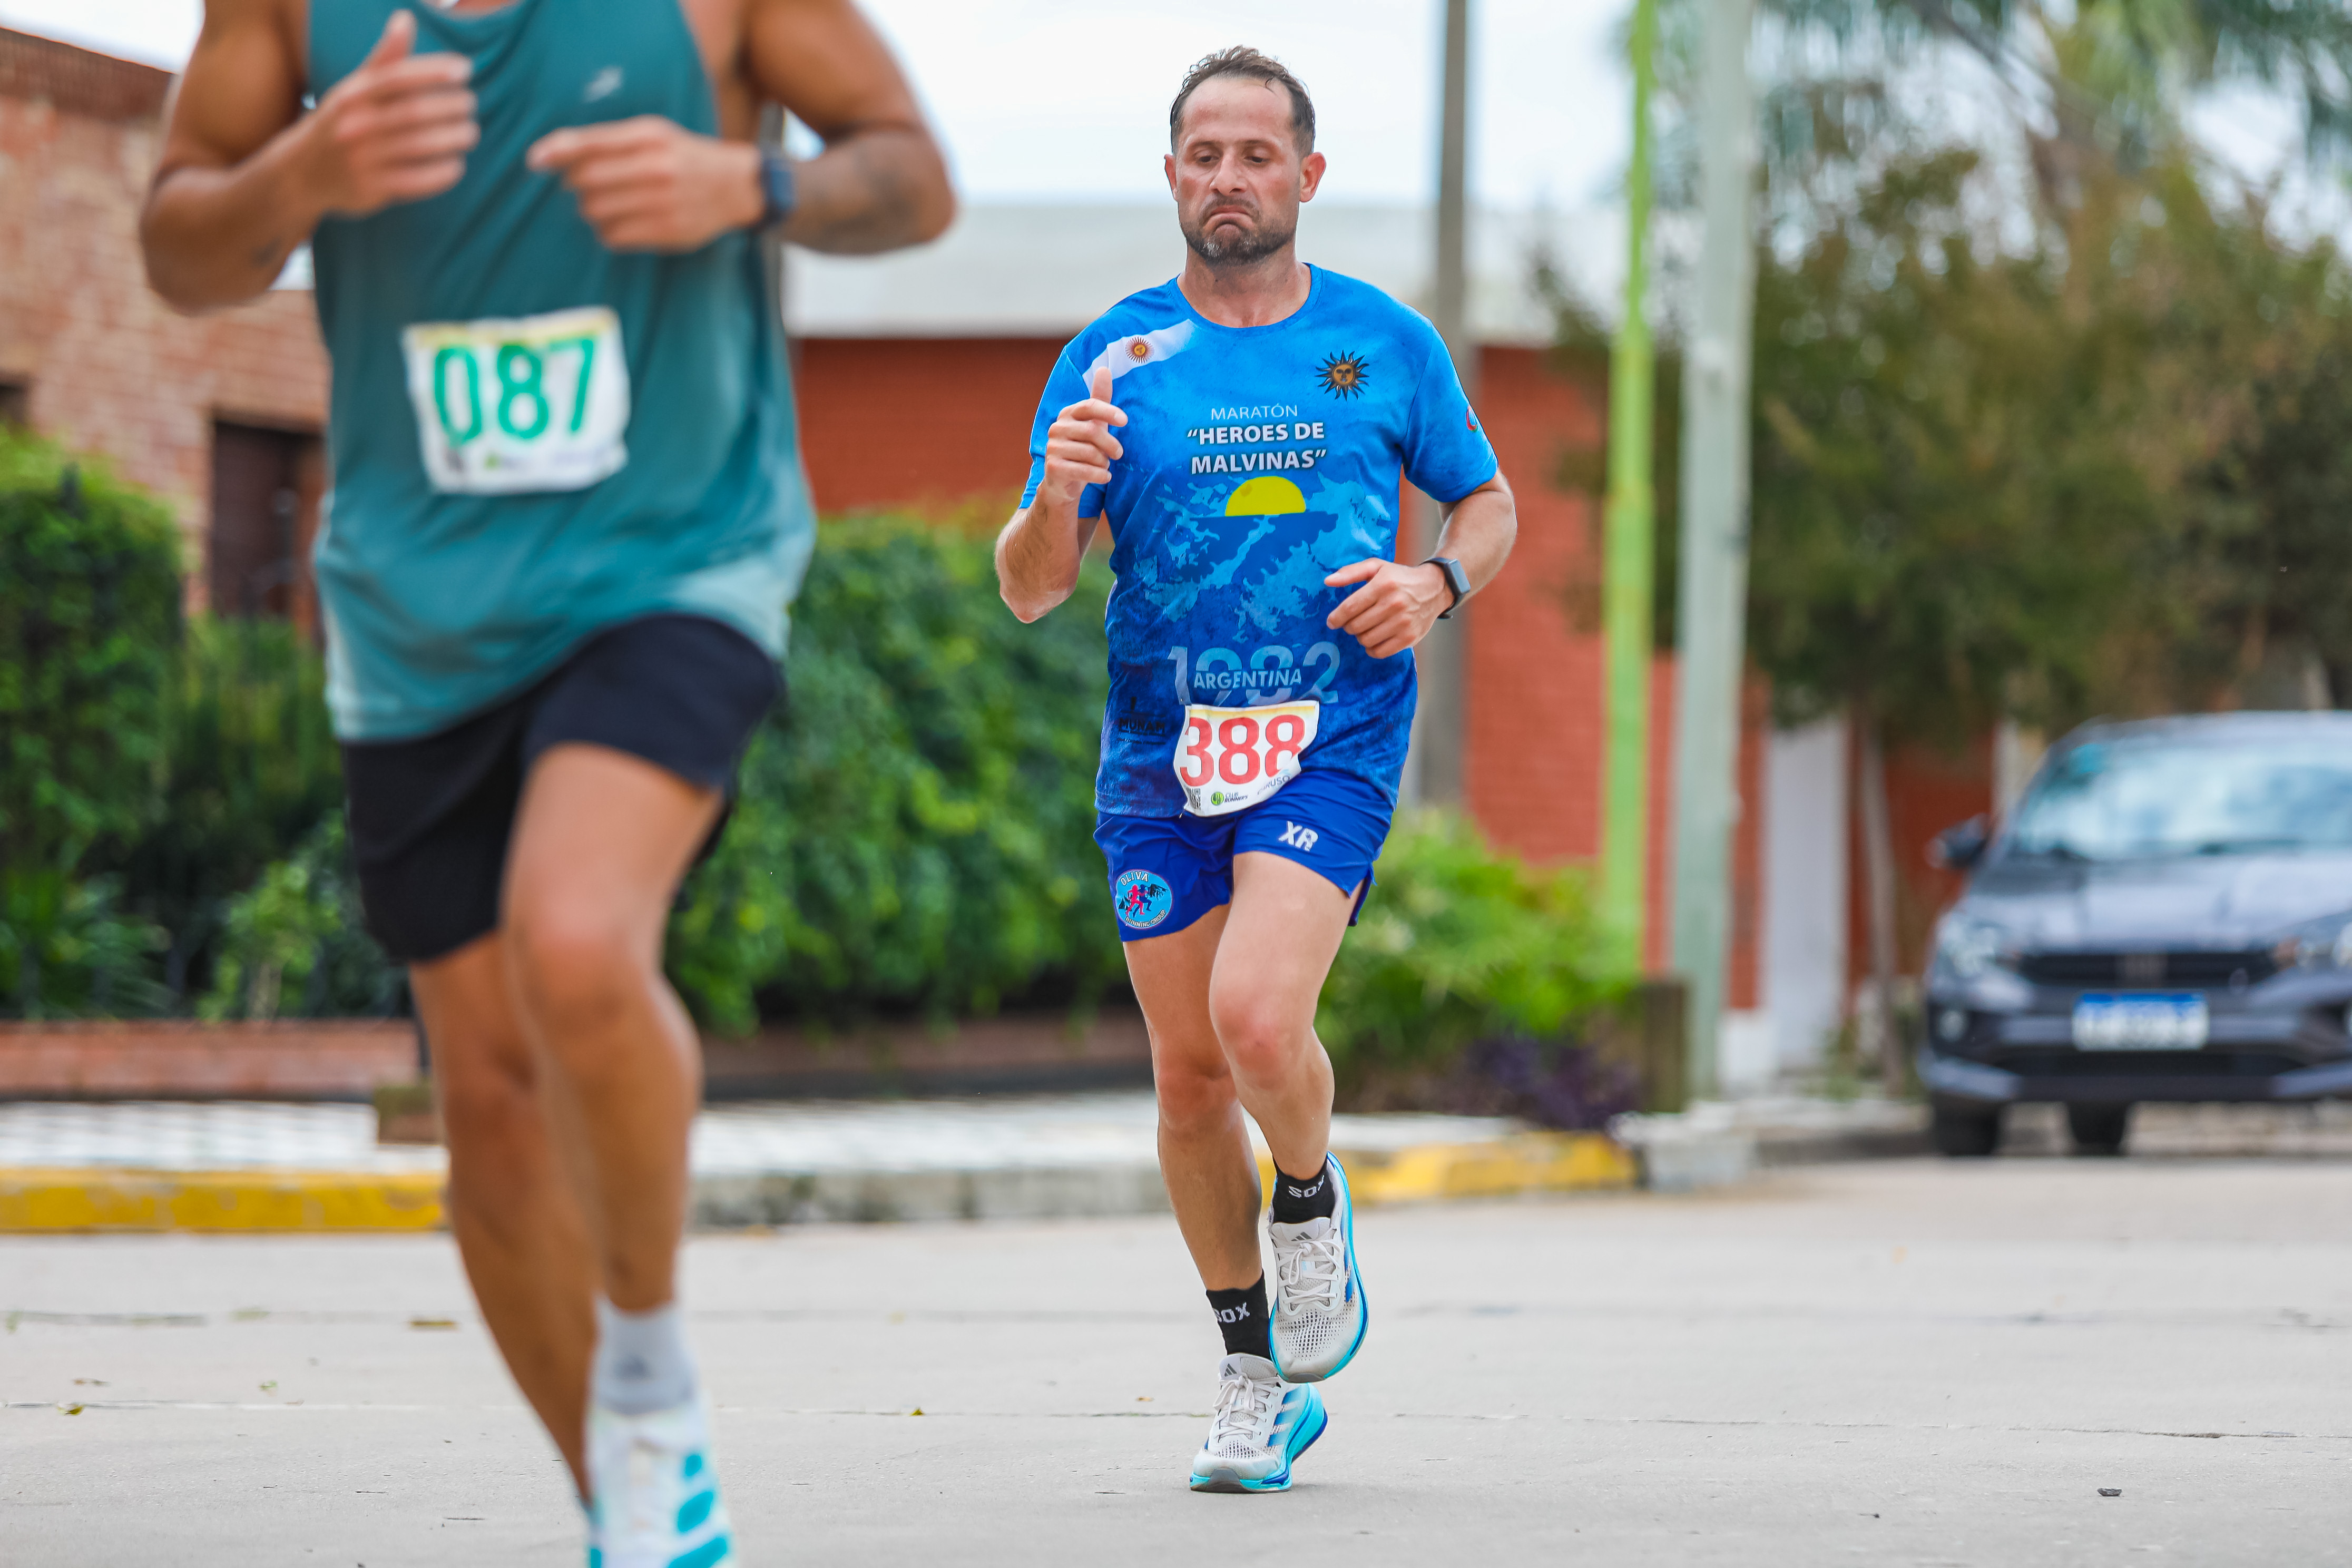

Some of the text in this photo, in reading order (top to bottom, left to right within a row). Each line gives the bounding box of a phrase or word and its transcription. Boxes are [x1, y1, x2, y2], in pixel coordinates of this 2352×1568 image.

[433, 336, 597, 448] 087
[1211, 403, 1298, 420] MARATÓN
[1295, 422, 1325, 440] DE
[1168, 641, 1340, 706] 1982
[1194, 668, 1301, 689] ARGENTINA
[1180, 714, 1305, 787] 388
[1120, 871, 1149, 886] OLIVA
[1125, 909, 1166, 927] RUNNING GROUP
